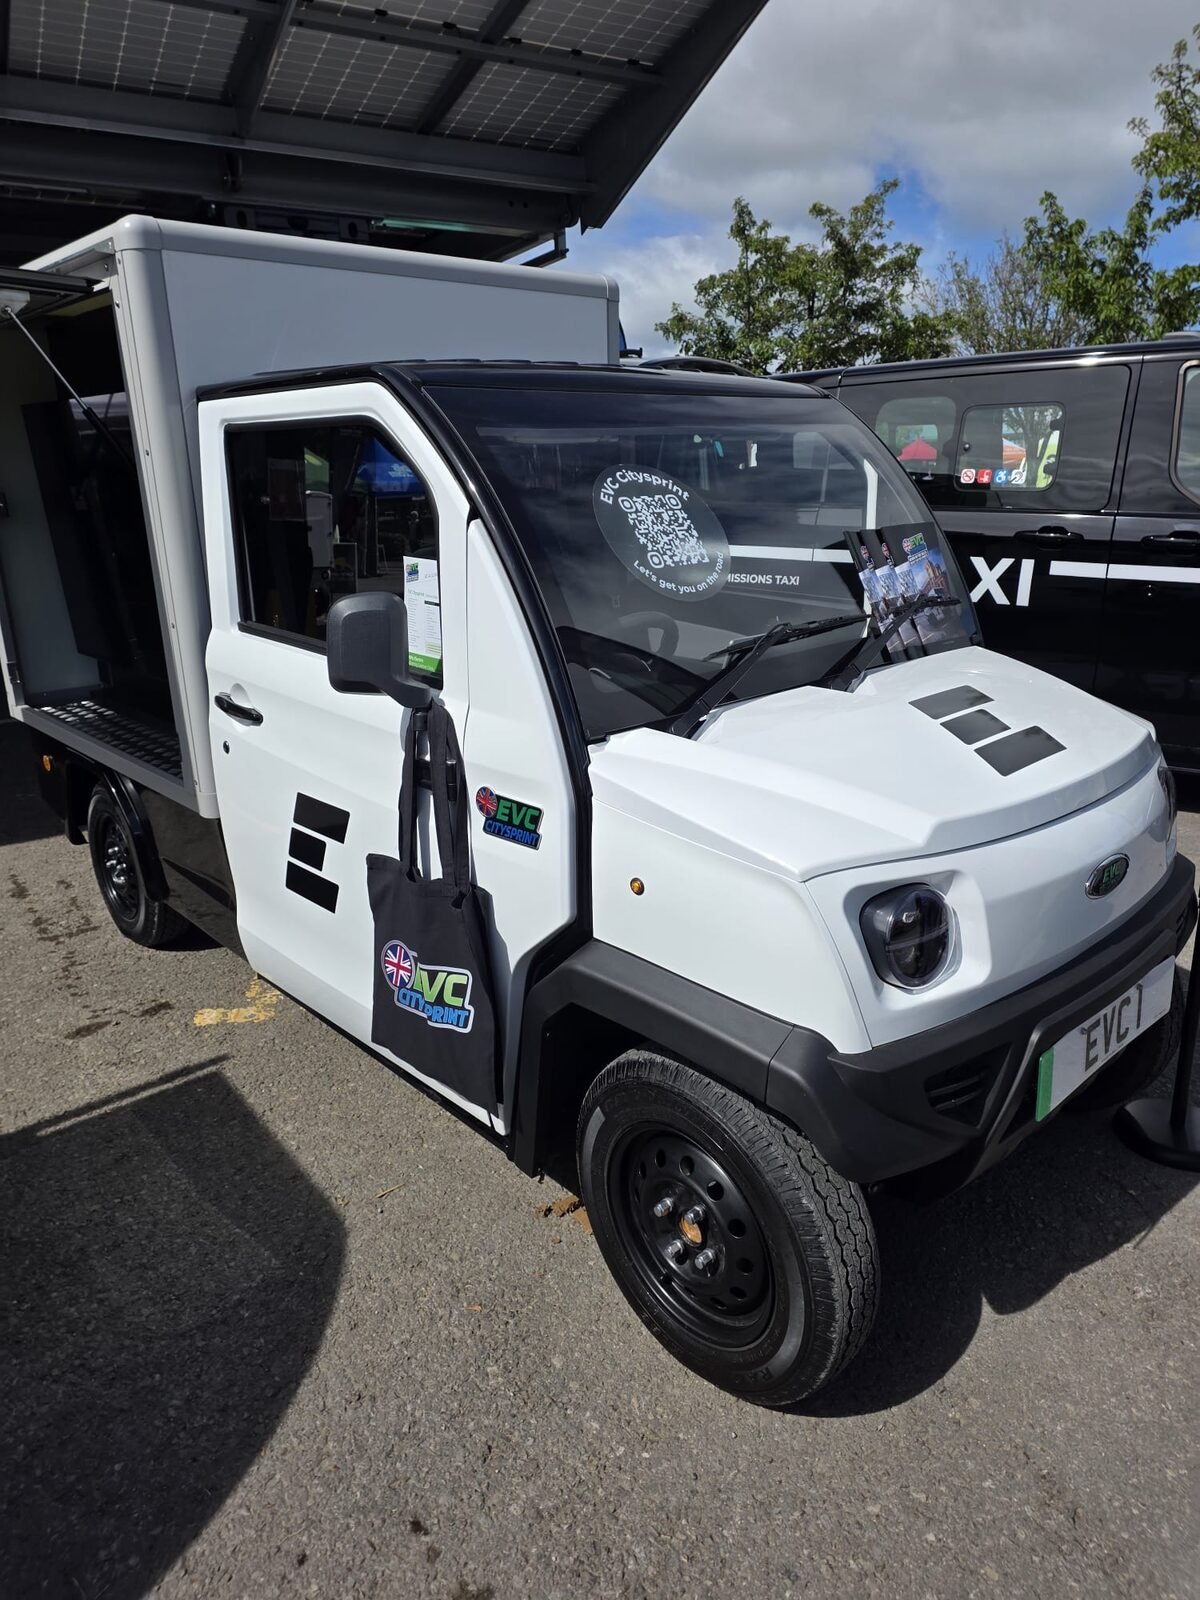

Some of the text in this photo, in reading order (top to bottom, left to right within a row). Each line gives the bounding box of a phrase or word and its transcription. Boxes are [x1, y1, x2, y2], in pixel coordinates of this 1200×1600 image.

[600, 469, 690, 505] EVC Citysprint
[633, 551, 724, 594] Let's get you on the road
[775, 575, 800, 586] TAXI
[969, 556, 1035, 607] XI
[485, 820, 539, 846] CITYSPRINT
[496, 799, 541, 831] EVC
[398, 987, 469, 1027] CITYPRINT
